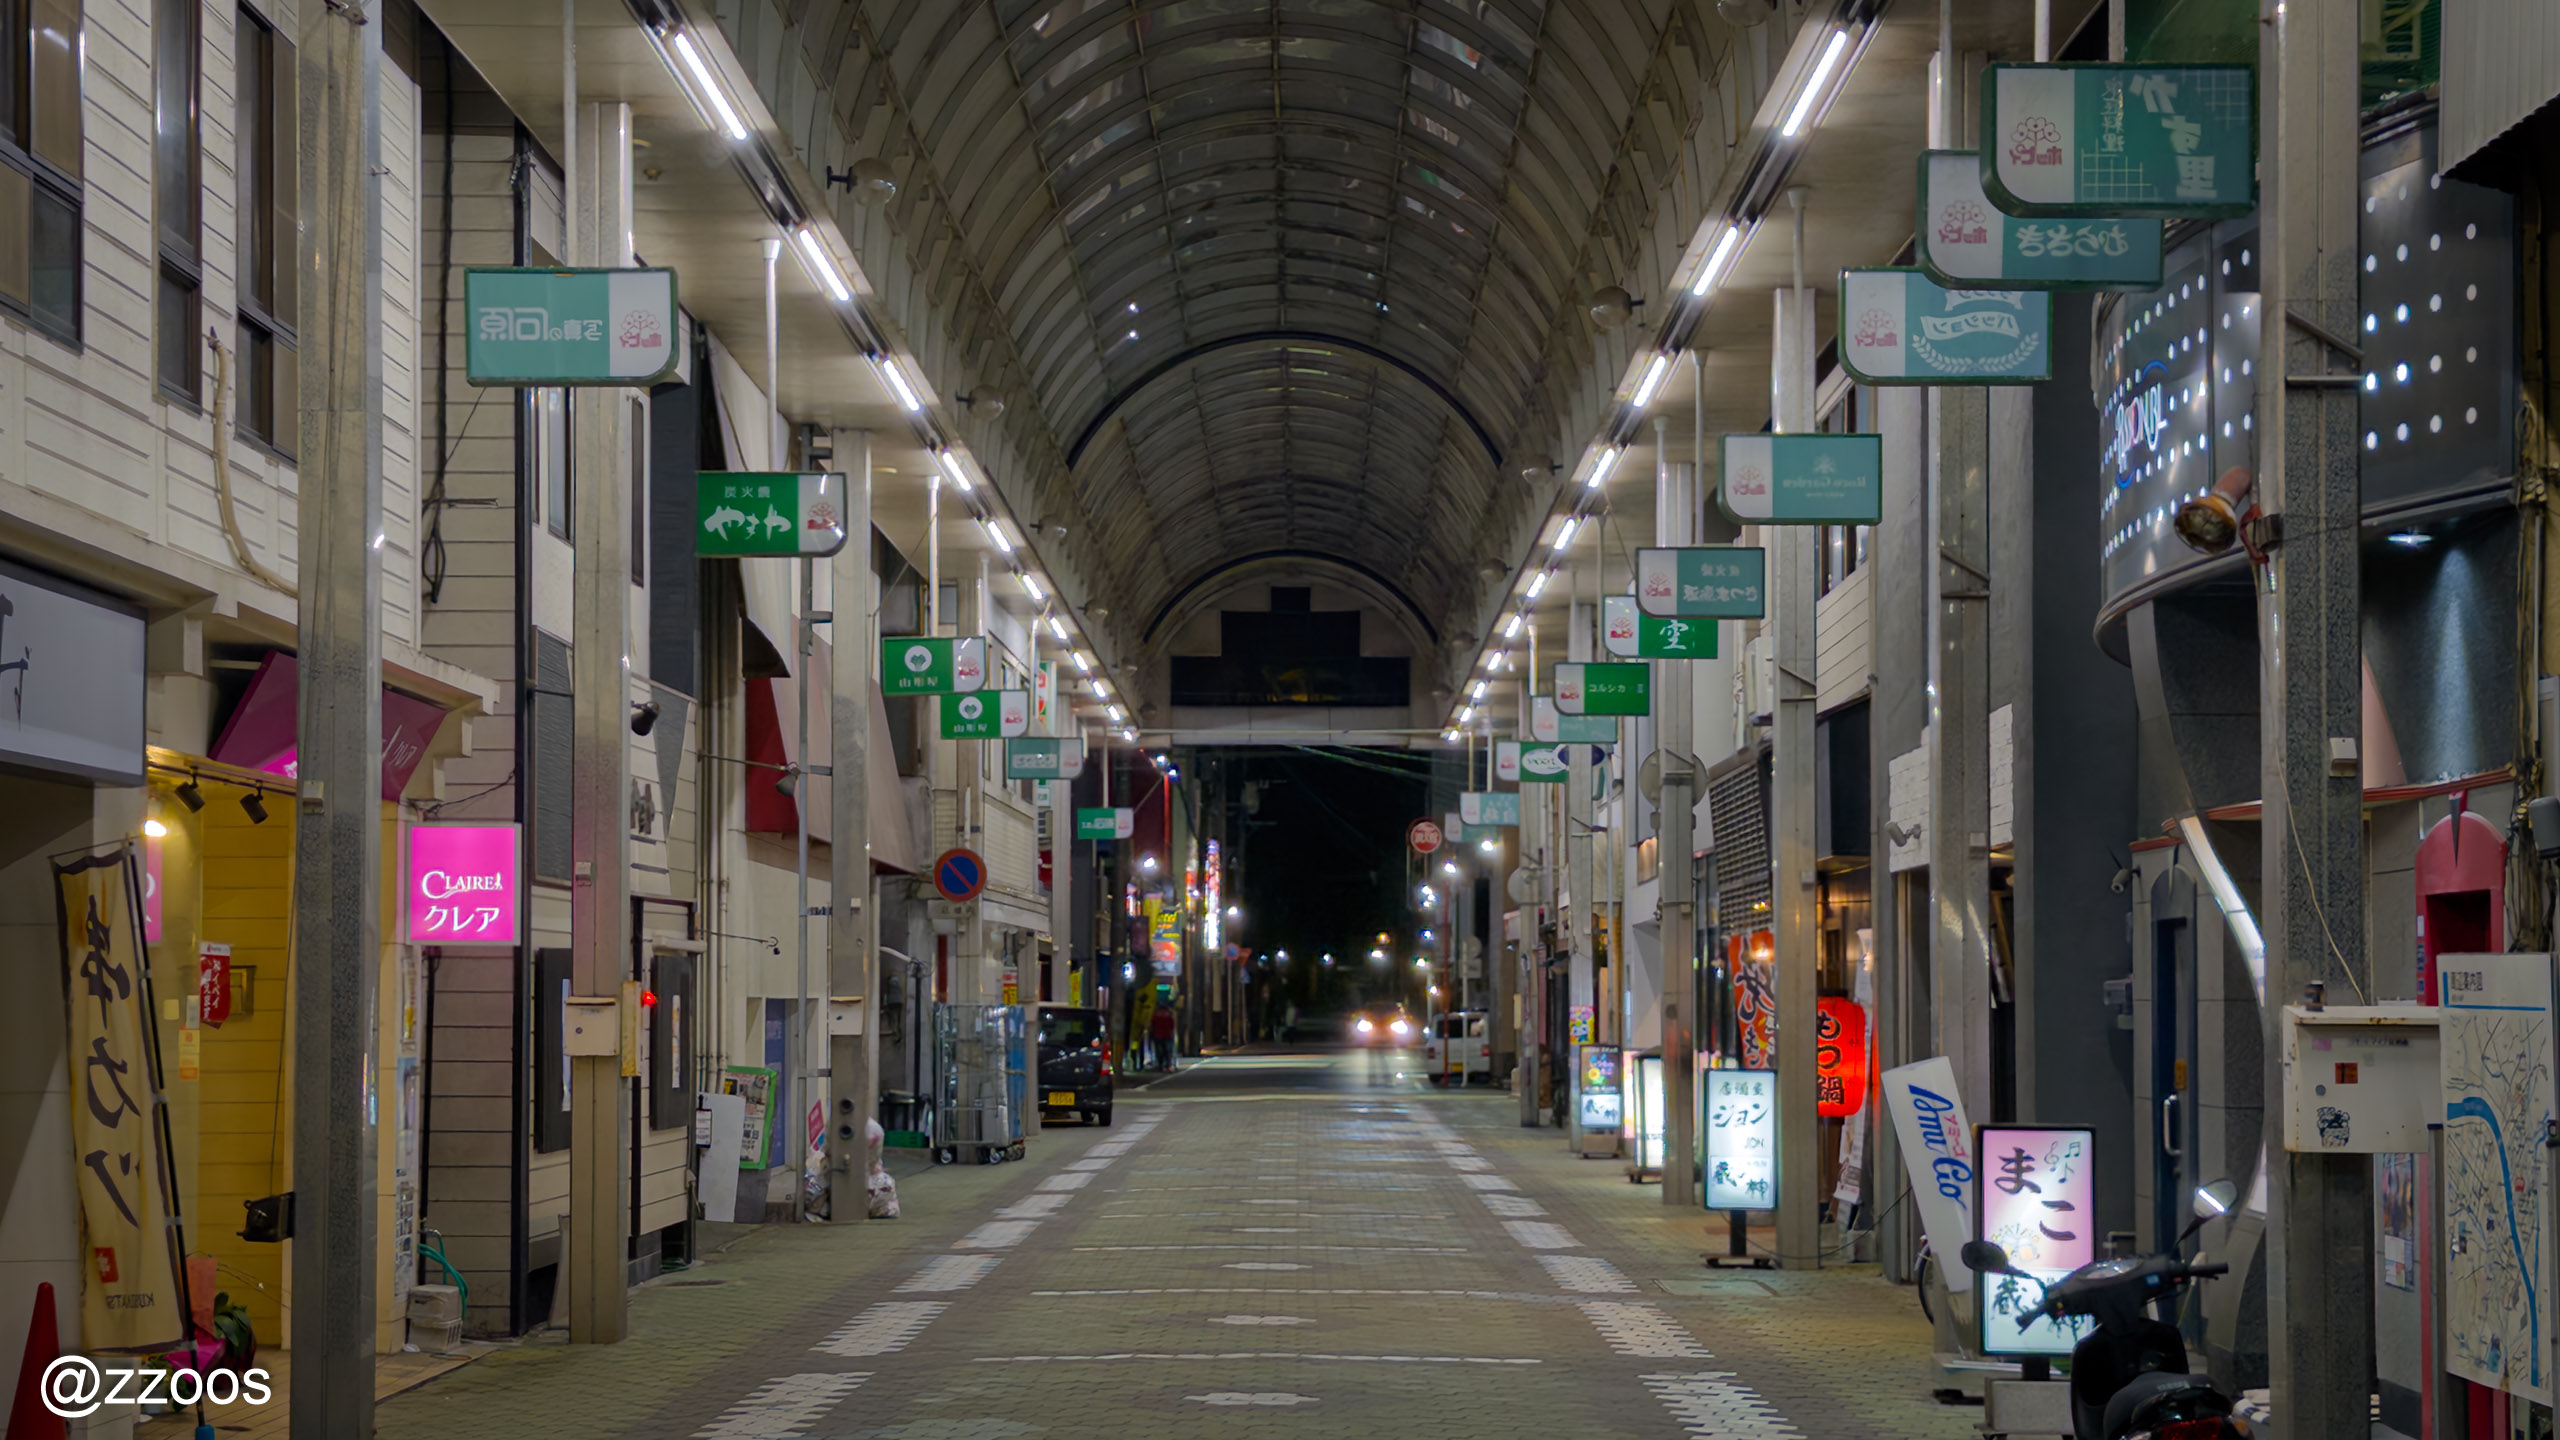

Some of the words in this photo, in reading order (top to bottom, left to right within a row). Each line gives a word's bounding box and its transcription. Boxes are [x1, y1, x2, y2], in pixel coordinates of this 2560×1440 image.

[421, 870, 494, 899] CLAIRE
[424, 905, 500, 932] クレア
[1713, 1103, 1769, 1128] ジョン
